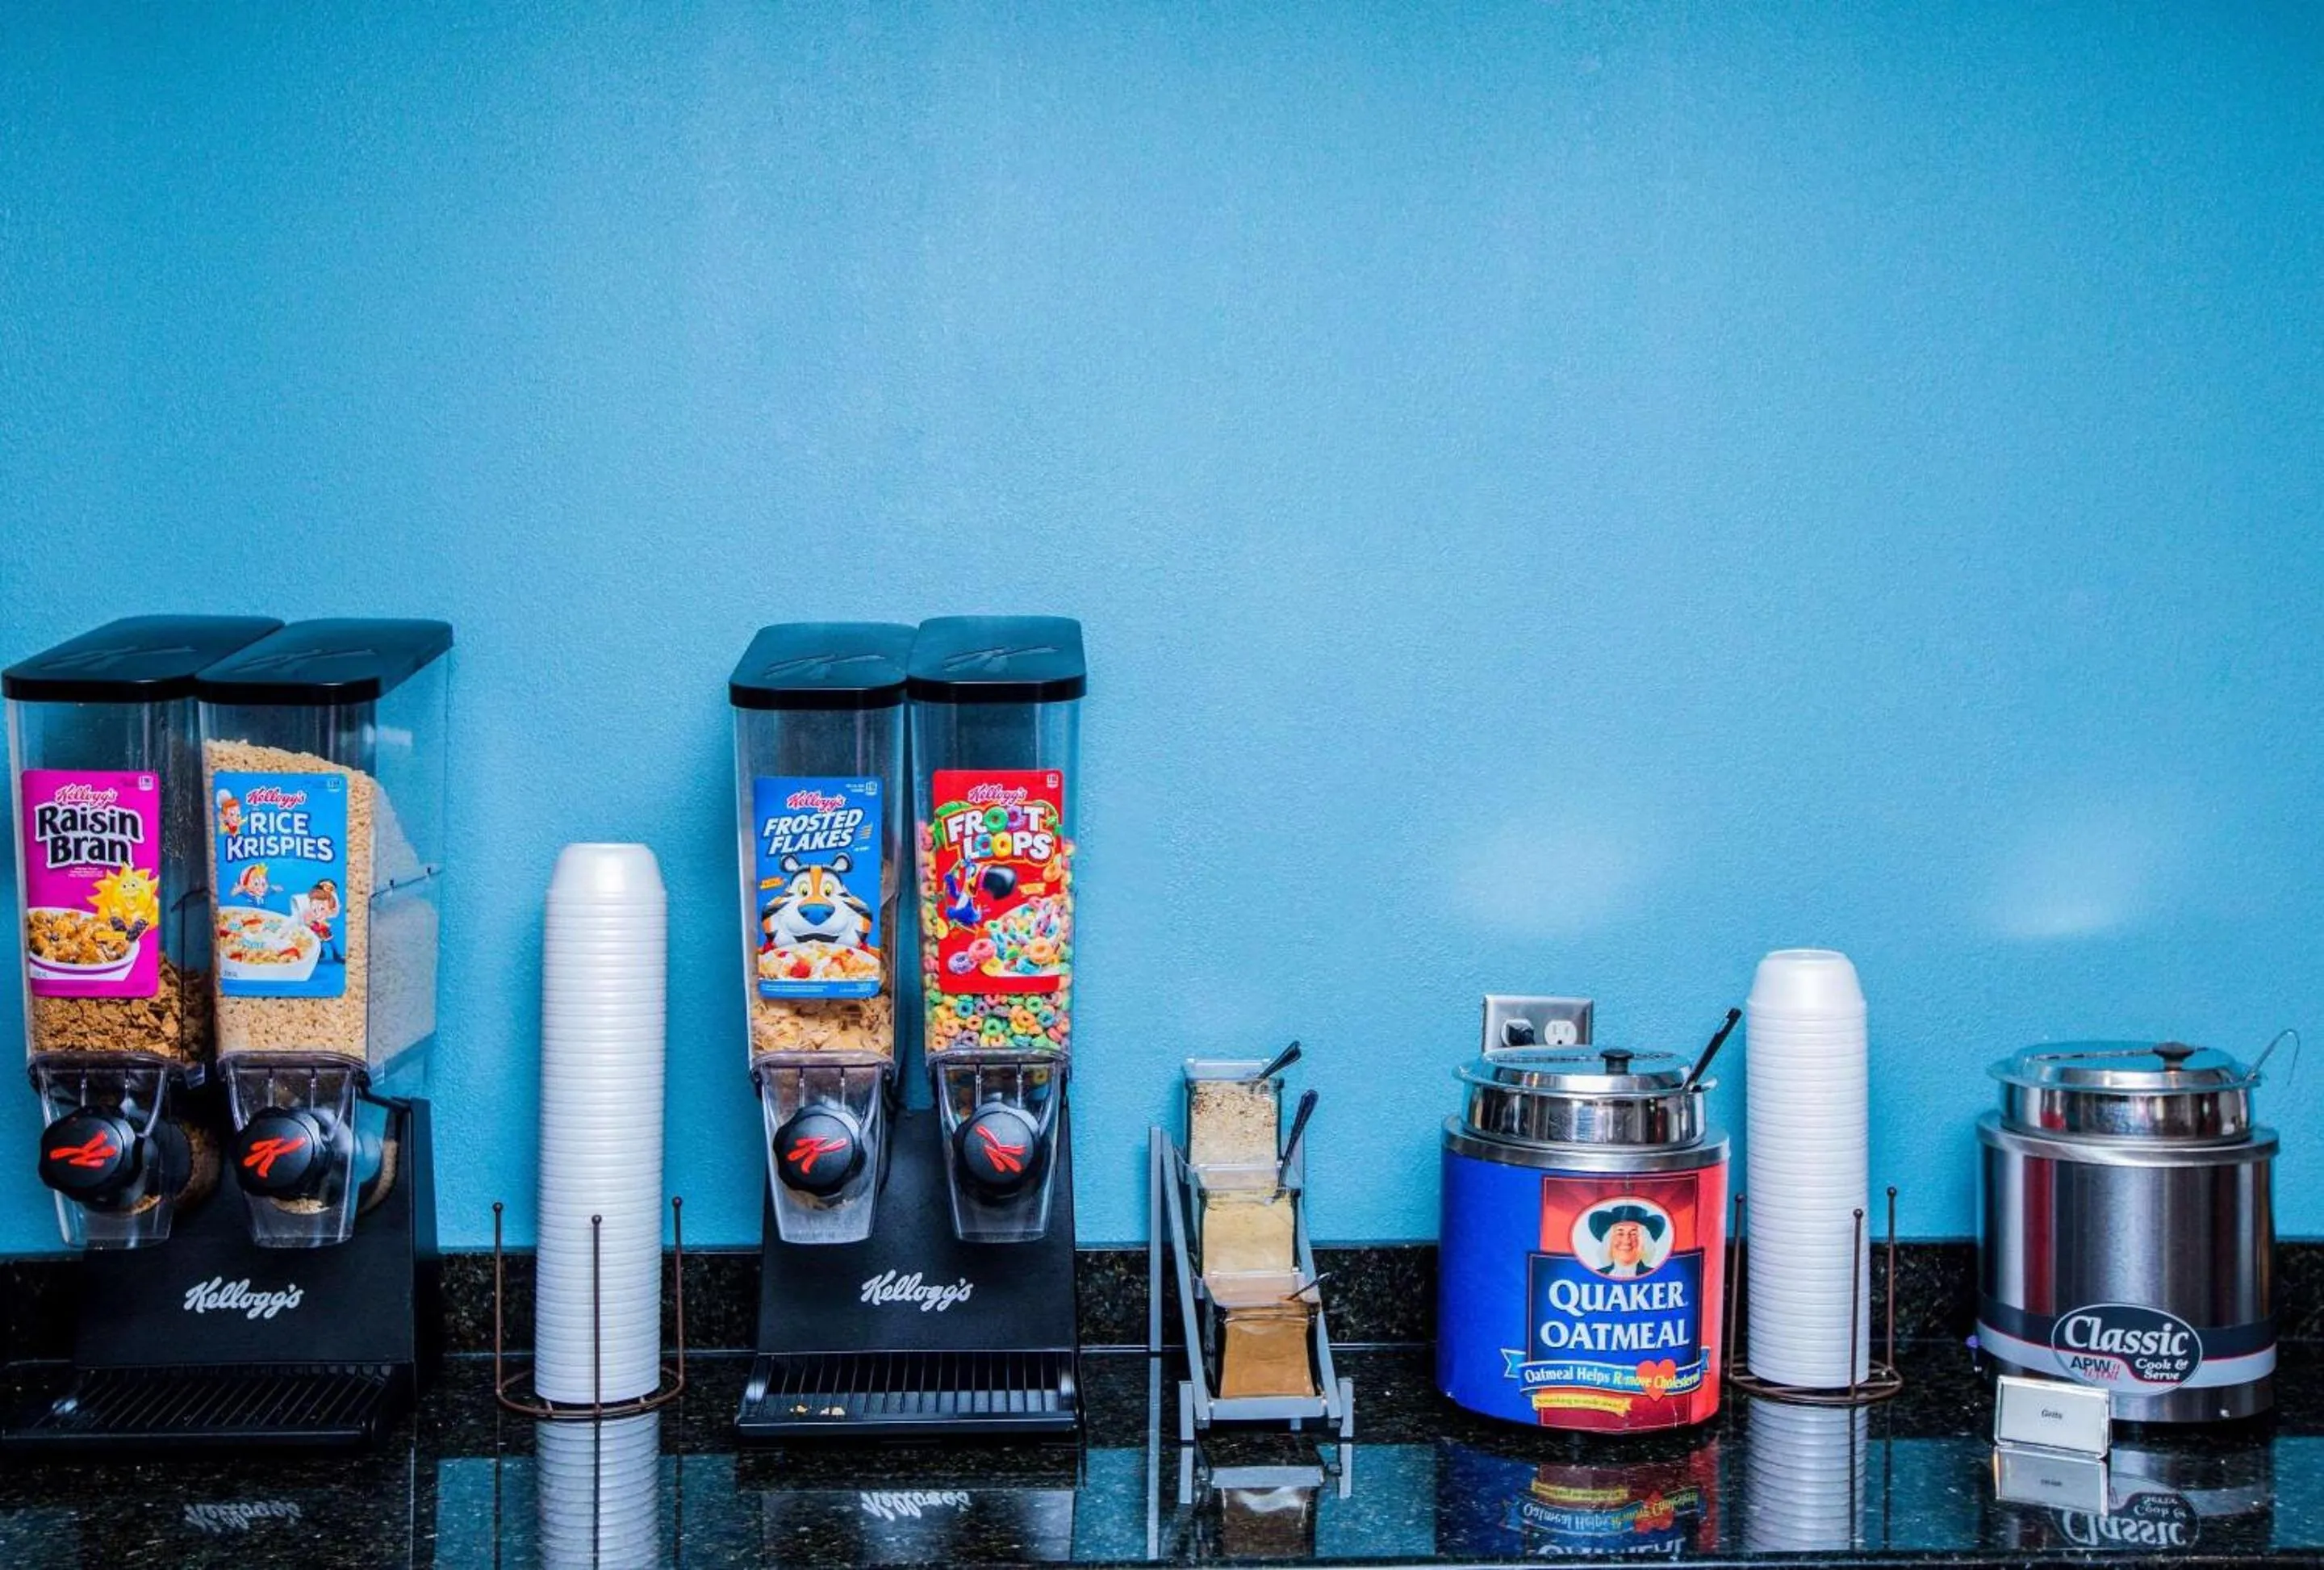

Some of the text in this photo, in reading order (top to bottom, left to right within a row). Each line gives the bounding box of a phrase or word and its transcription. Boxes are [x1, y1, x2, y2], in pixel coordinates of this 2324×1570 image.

[55, 783, 118, 807] Kellogg's
[246, 785, 307, 810] Kellogg's
[787, 790, 846, 812] Kellogg's
[968, 783, 1027, 806] Kellogg's
[37, 806, 141, 840] Raisin
[249, 811, 310, 835] RICE
[763, 808, 864, 837] FROSTED
[947, 805, 1046, 843] FROOT
[49, 835, 130, 865] Bran
[226, 835, 334, 862] KRISPIES
[768, 827, 855, 855] FLAKES
[963, 831, 1054, 860] LOOPS
[183, 1275, 305, 1320] Kellogg's
[860, 1268, 974, 1312] Kellogg's
[1548, 1279, 1687, 1317] QUAKER
[1540, 1319, 1691, 1350] OATMEAL
[2063, 1315, 2189, 1356] Classic
[1524, 1365, 1574, 1384] Oatmeal
[1576, 1367, 1611, 1385] Helps
[2069, 1356, 2111, 1371] APW
[2134, 1357, 2172, 1370] Cook
[2143, 1368, 2180, 1380] Serve
